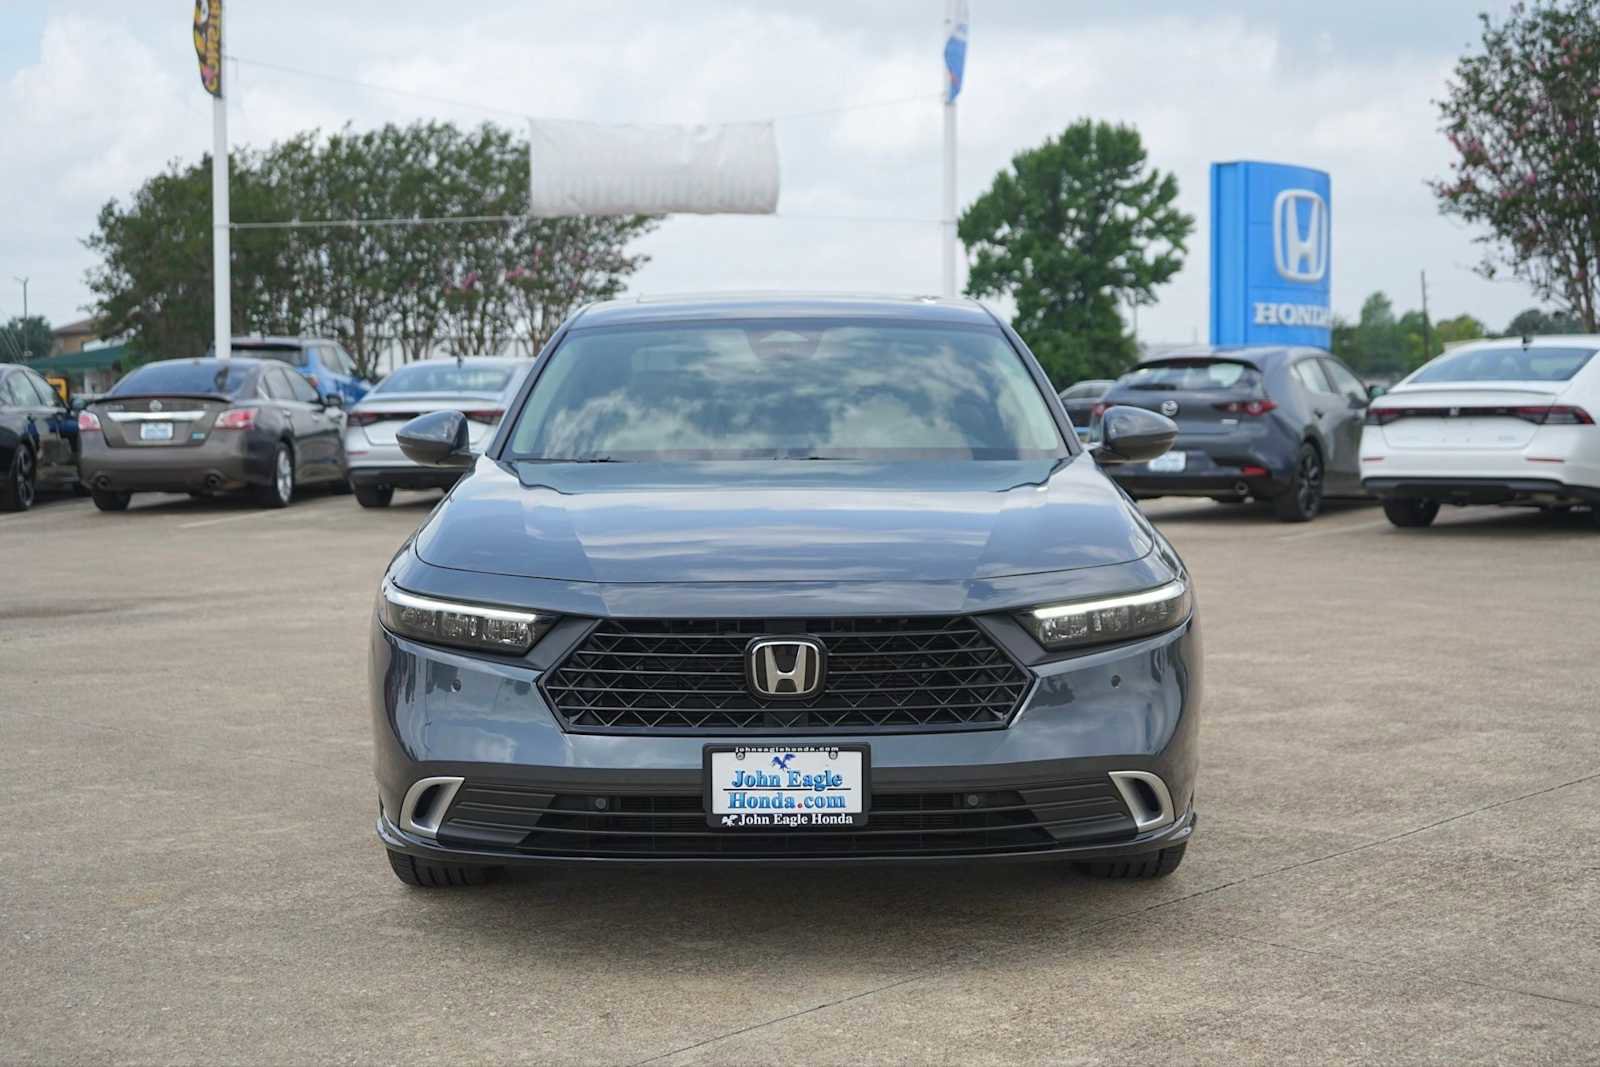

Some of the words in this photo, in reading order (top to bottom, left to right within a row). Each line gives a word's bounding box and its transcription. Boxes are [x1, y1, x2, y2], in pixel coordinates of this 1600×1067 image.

[1254, 303, 1331, 327] HOND
[731, 770, 781, 788] John
[787, 769, 843, 791] Eagle
[727, 792, 846, 809] Honda.com
[738, 813, 770, 826] John
[774, 813, 807, 827] Eagle
[811, 813, 853, 825] Honda
